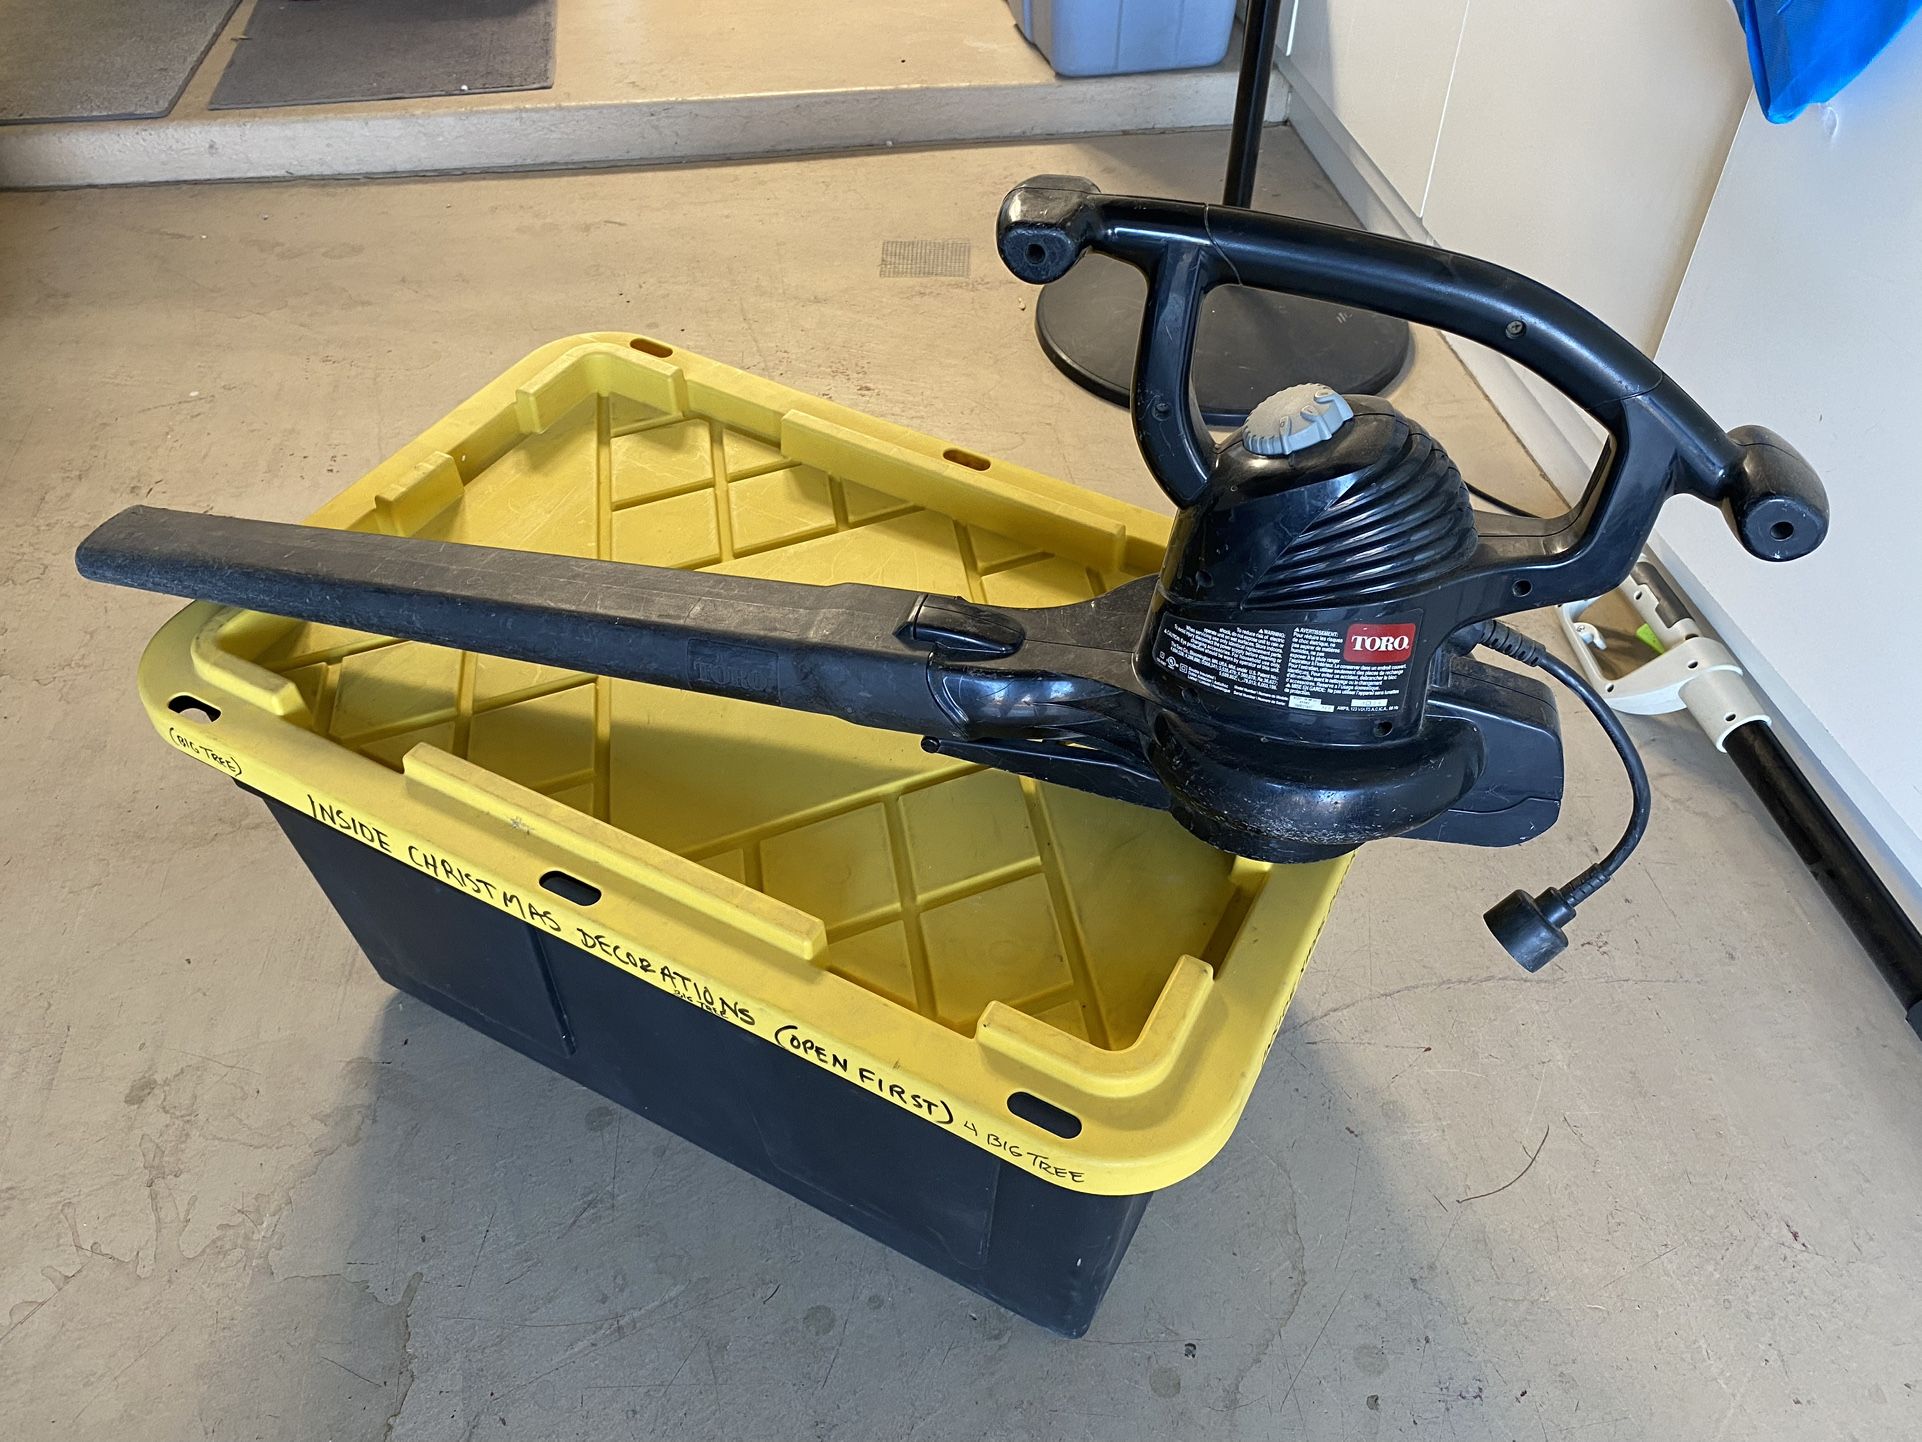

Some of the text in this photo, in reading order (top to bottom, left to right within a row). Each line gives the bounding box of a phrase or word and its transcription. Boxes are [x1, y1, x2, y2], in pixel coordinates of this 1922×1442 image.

[1264, 629, 1285, 638] WARNING:
[1300, 628, 1338, 637] AVERTISSEMENT:
[1191, 639, 1207, 648] changing
[1195, 635, 1213, 644] disconnect
[1196, 630, 1211, 639] servicing
[1229, 641, 1245, 649] identical
[1246, 646, 1270, 655] replacement
[1351, 635, 1409, 651] TORO
[1187, 642, 1204, 652] protection
[169, 727, 243, 777] (BIG TREE)
[307, 794, 392, 853] INSIDE
[577, 927, 755, 1025] DECORATIONS
[774, 1025, 849, 1073] (OPEN
[858, 1067, 954, 1125] FIRST)
[987, 1134, 1023, 1158] BIG
[1026, 1152, 1085, 1183] TREE
